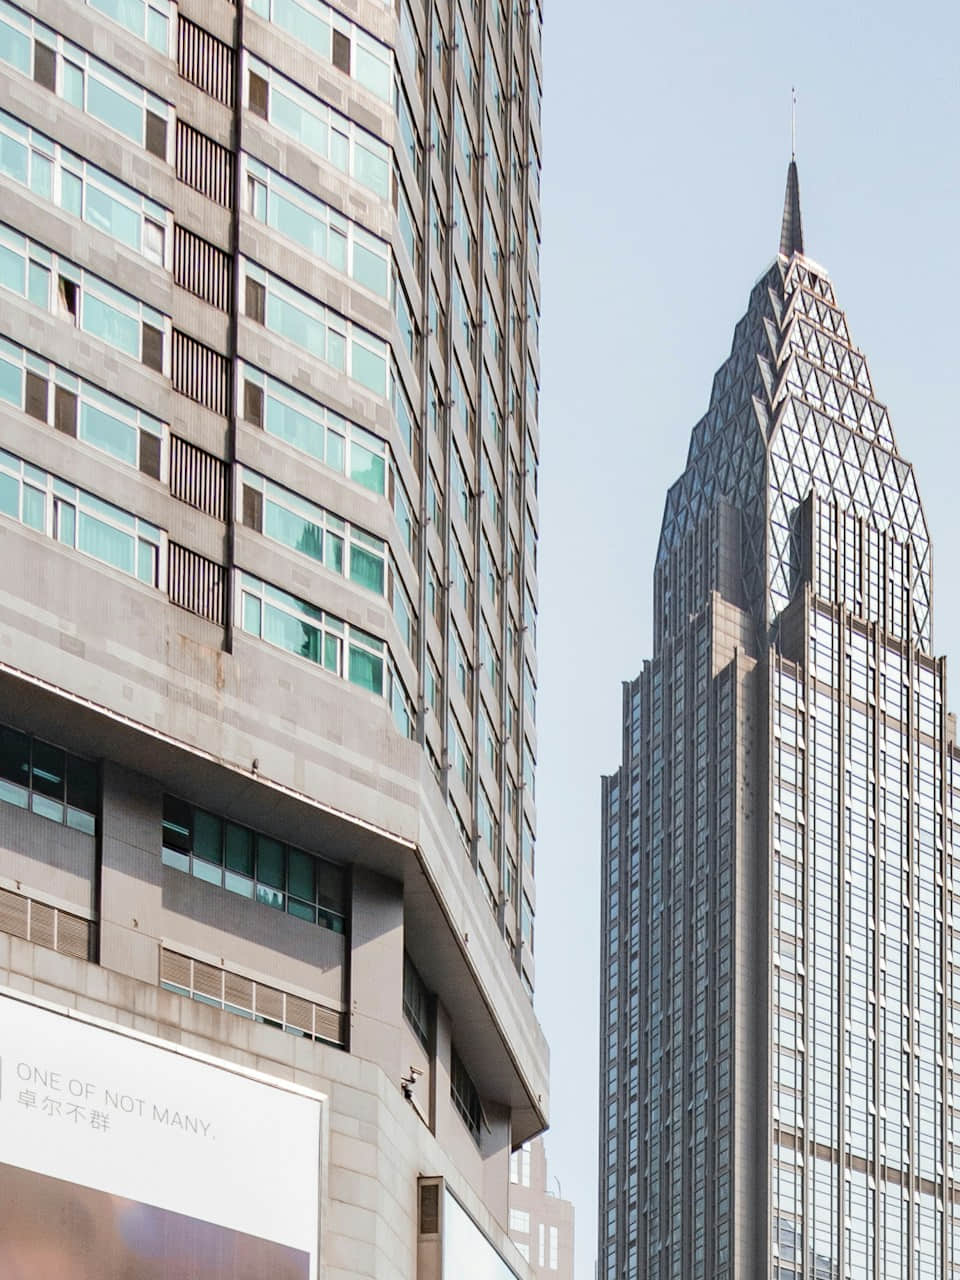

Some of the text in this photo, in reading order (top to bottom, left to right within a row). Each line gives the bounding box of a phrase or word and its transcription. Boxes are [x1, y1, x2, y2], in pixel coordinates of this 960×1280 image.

[17, 1062, 216, 1140] ONE OF NOT MANY.
[17, 1089, 111, 1132] 卓尔不群
